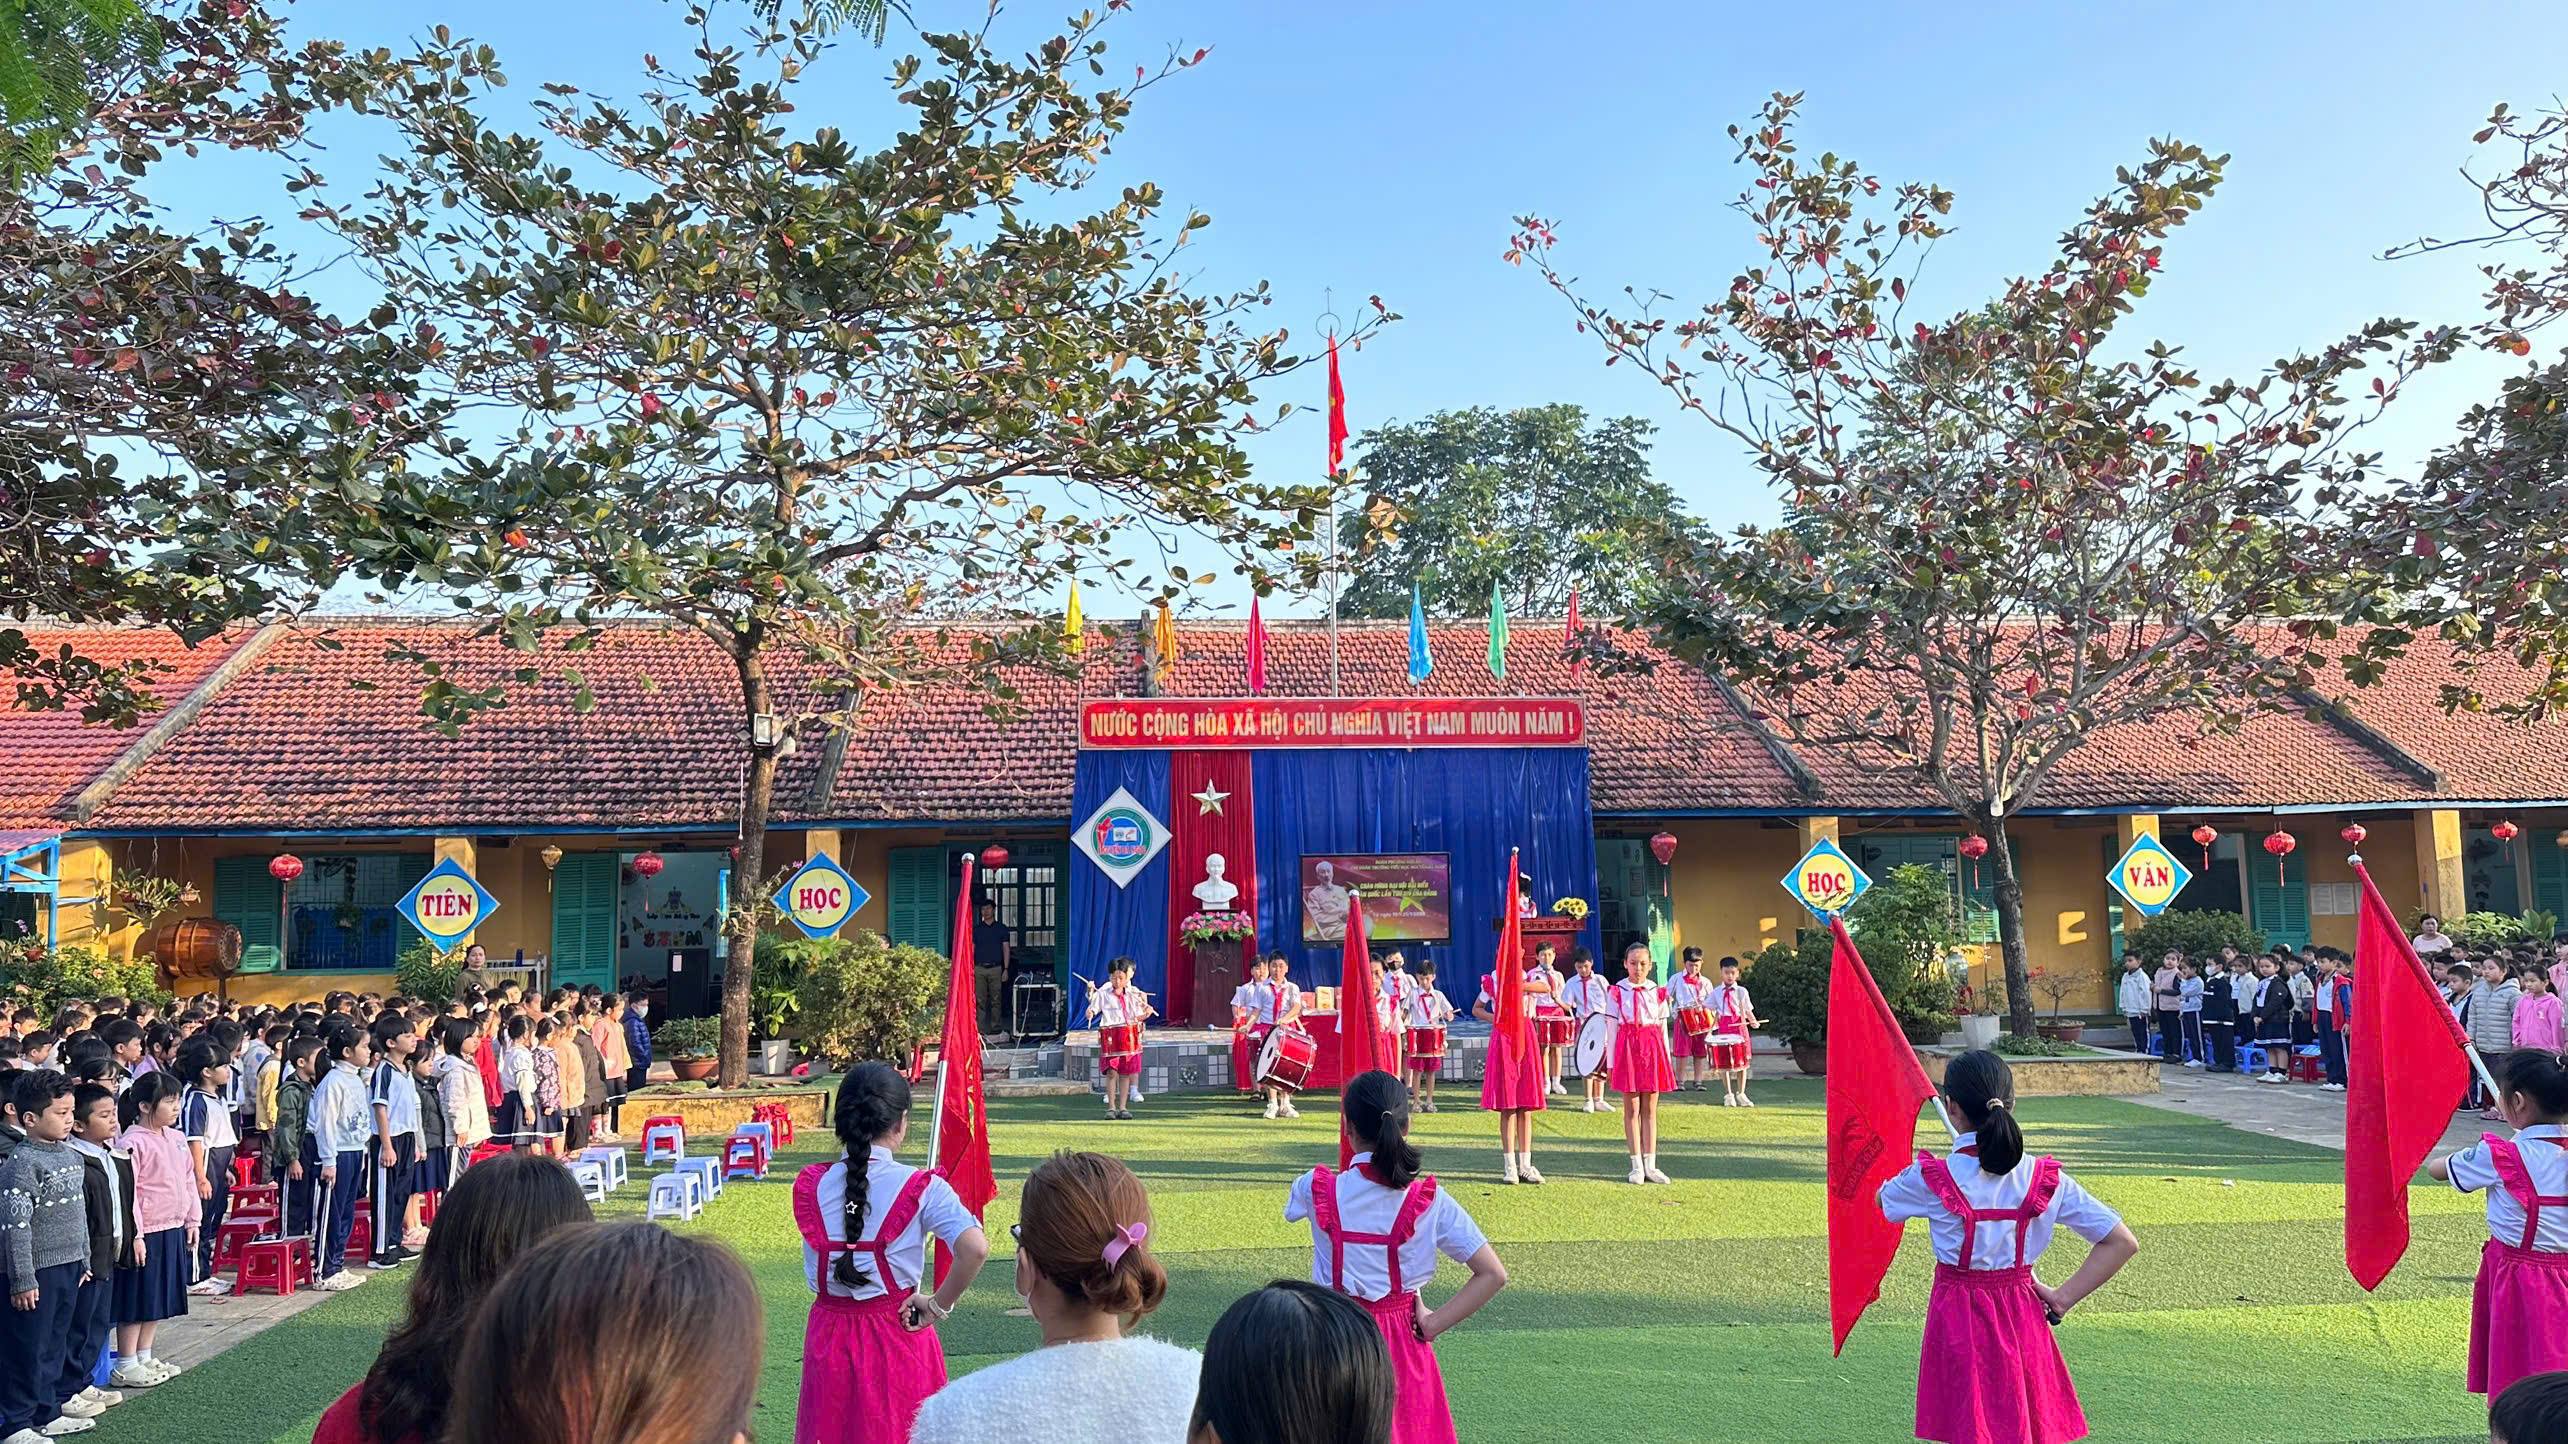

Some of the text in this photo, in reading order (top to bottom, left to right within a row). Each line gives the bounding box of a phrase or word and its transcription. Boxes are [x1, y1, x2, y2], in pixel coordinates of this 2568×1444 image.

[1090, 707, 1137, 737] NƯỚC
[1142, 707, 1189, 741] CỘNG
[1194, 708, 1228, 737] HÒA
[1232, 707, 1256, 737] XÃ
[1260, 708, 1288, 741] HỘI
[1294, 704, 1327, 736] CHỦ
[1331, 708, 1383, 736] NGHĨA
[1386, 707, 1422, 740] VIỆT
[1427, 711, 1466, 736] NAM
[1471, 707, 1520, 736] MUÔN
[1525, 707, 1564, 735] NĂM
[1807, 872, 1846, 897] HỌC
[2129, 860, 2169, 887] VĂN
[421, 887, 472, 916] TIÊN
[799, 887, 841, 914] HỌC
